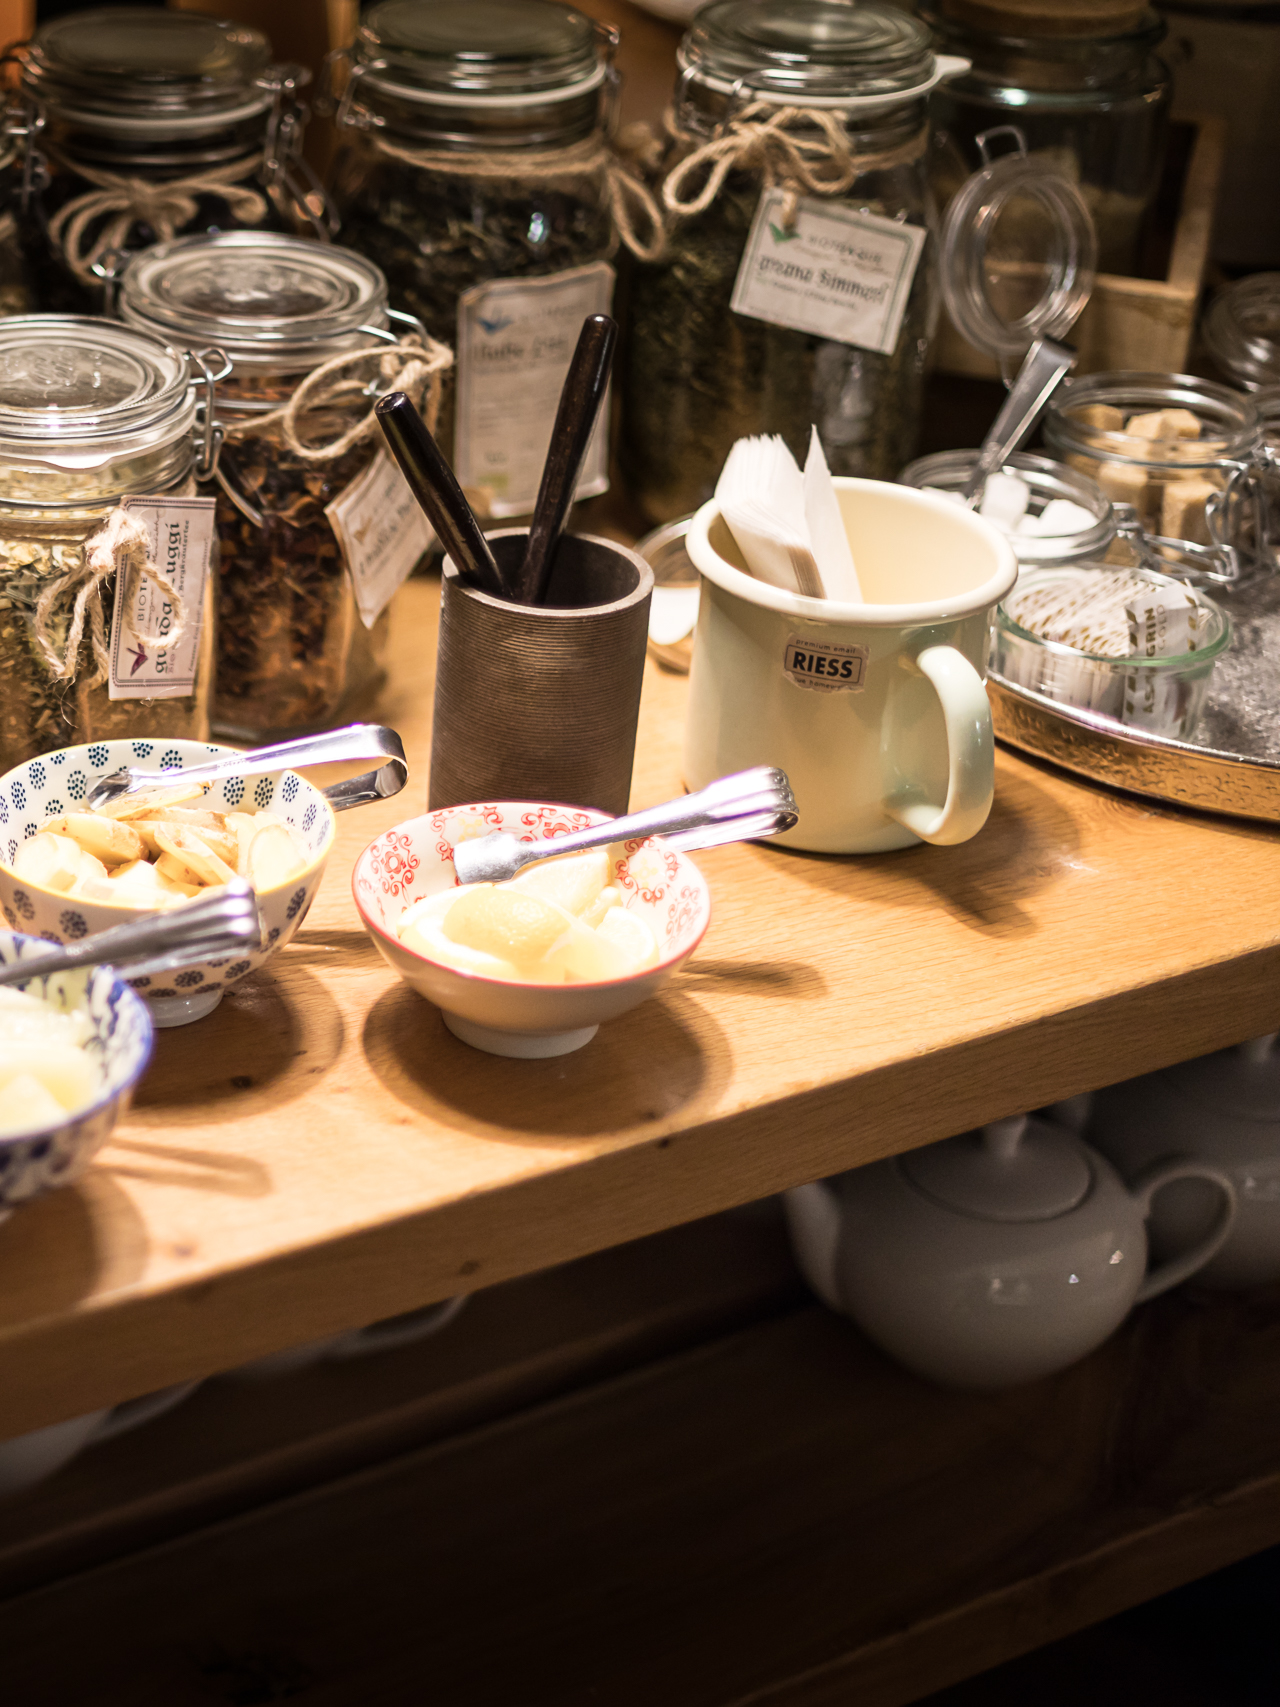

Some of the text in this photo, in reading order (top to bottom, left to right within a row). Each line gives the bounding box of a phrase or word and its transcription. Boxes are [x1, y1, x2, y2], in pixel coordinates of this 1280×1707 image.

[165, 522, 182, 587] uggi
[796, 639, 856, 654] premium email
[793, 651, 853, 678] RIESS
